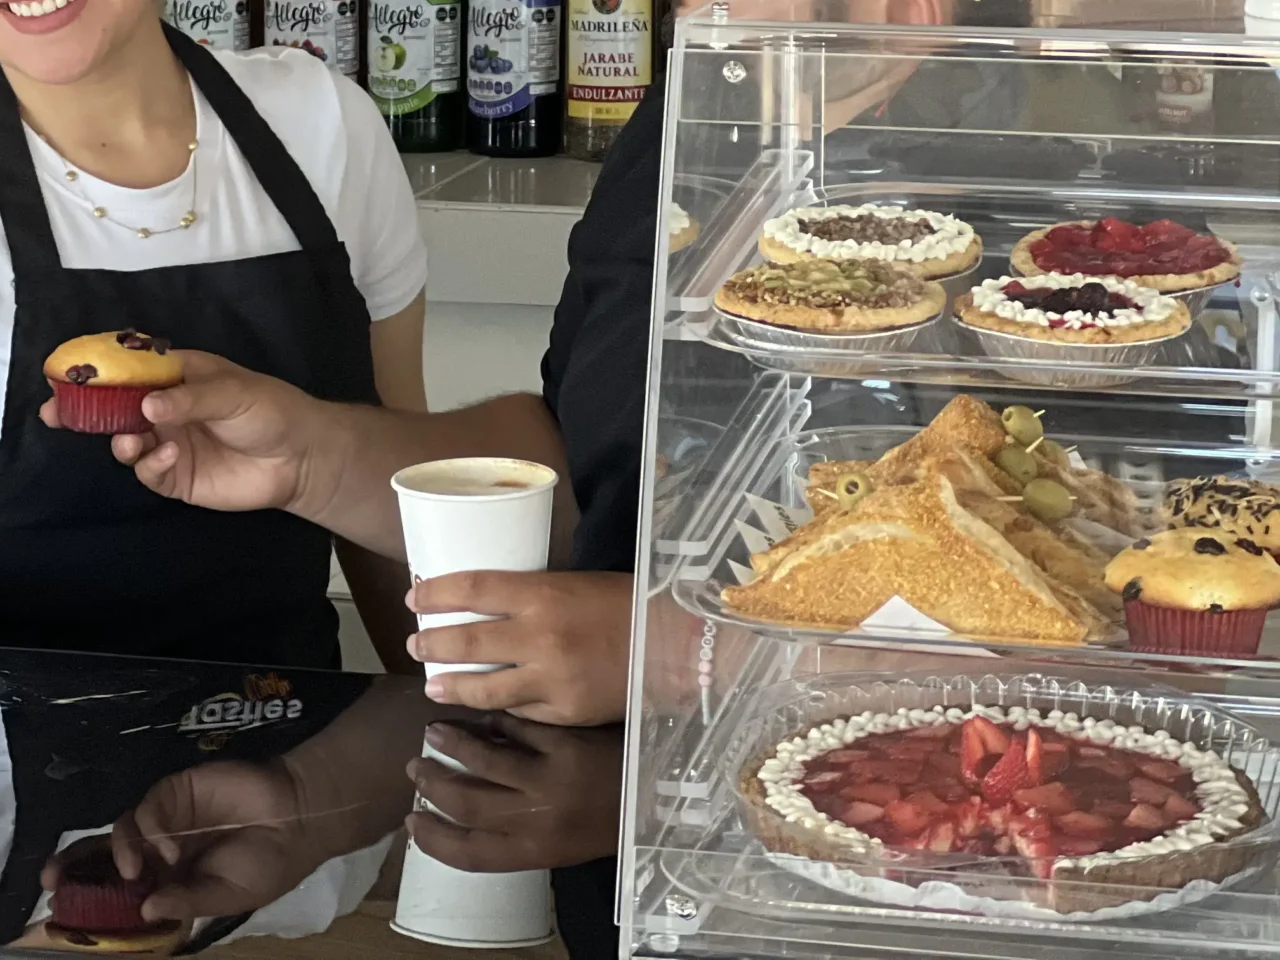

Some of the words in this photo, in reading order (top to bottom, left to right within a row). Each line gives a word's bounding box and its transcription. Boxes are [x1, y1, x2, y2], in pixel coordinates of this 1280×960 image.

[171, 0, 228, 30] Allegro
[272, 1, 328, 32] Allegro
[373, 3, 424, 35] Allegro
[470, 5, 521, 37] Allegro
[571, 18, 649, 33] MADRILEÑA
[578, 65, 639, 78] NATURAL
[583, 52, 635, 65] JARABE
